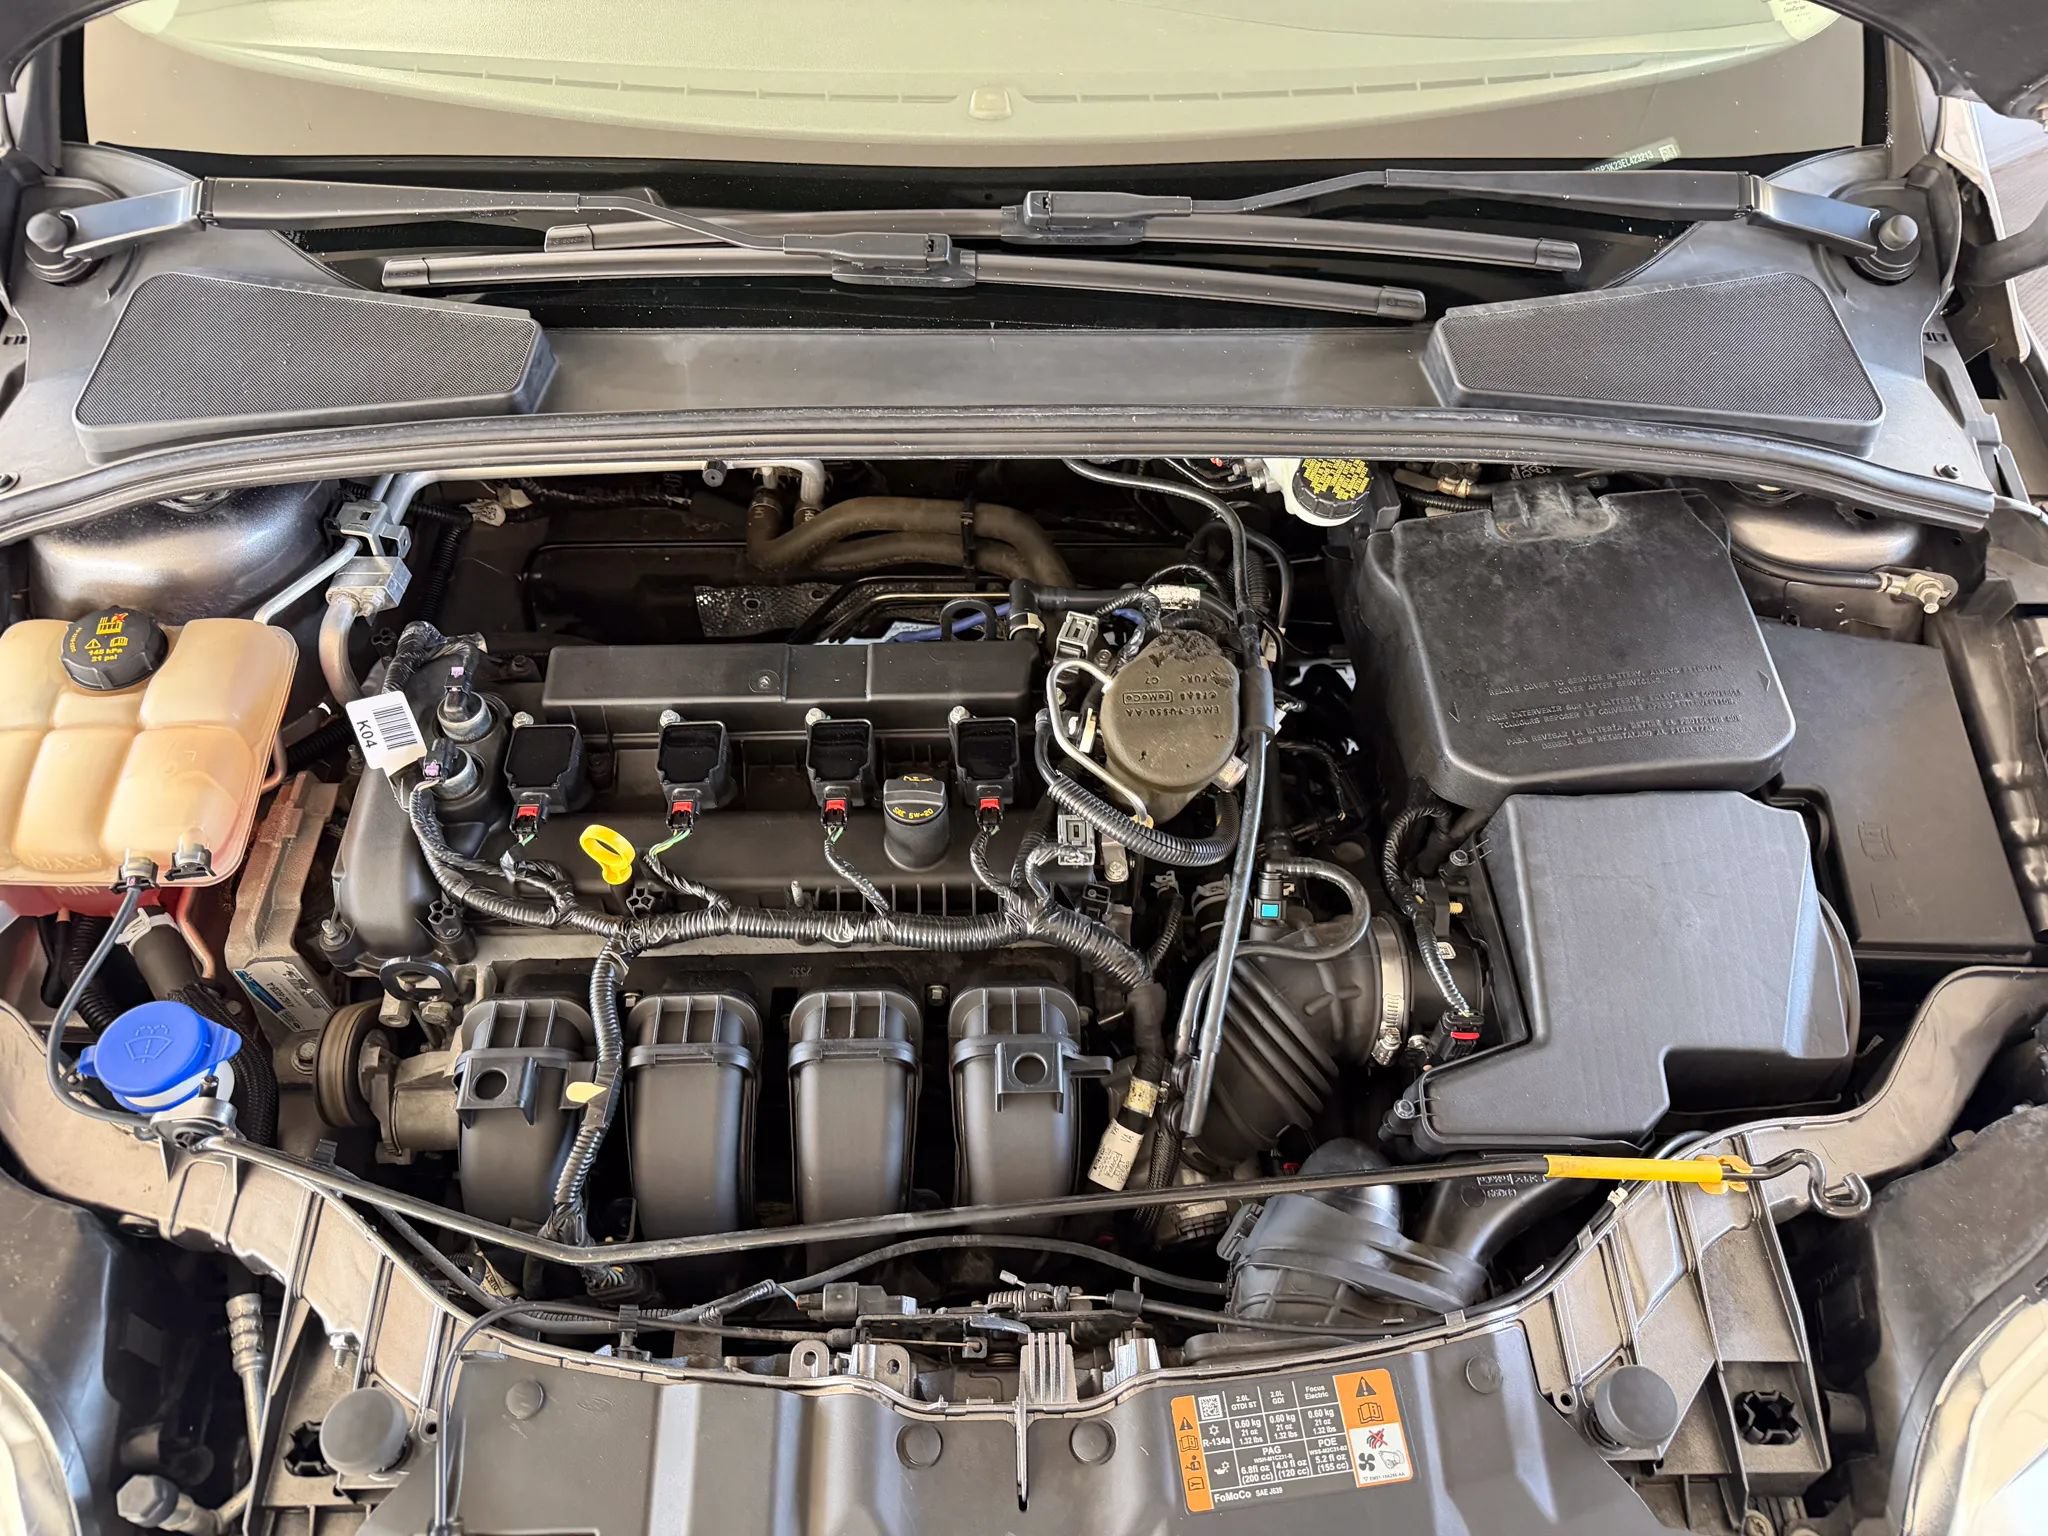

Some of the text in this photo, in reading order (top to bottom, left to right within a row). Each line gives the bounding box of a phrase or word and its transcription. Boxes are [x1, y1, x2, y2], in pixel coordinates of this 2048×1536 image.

[104, 654, 118, 662] psi
[1523, 680, 1550, 691] COVER
[1553, 679, 1565, 687] TO
[1567, 674, 1602, 686] SERVICE
[1558, 685, 1584, 695] COVER
[1588, 682, 1614, 692] AFTER
[1126, 691, 1171, 703] FoMoCo
[1585, 700, 1597, 709] LA
[1543, 712, 1581, 723] REPOSER
[356, 719, 378, 749] K04
[1506, 736, 1529, 746] PARA
[1531, 730, 1568, 742] REVISAR
[892, 806, 934, 819] SAE 5W-20
[1270, 1390, 1284, 1398] 2.0L
[1305, 1385, 1326, 1393] Focus
[1236, 1395, 1250, 1403] 2.0L
[1304, 1391, 1329, 1400] Electric
[1248, 1401, 1257, 1409] ST
[1269, 1413, 1296, 1423] 0.60 kg
[1307, 1408, 1335, 1419] 0.60 kg
[1234, 1418, 1262, 1429] 0.60 kg
[1314, 1419, 1322, 1427] 21
[1274, 1431, 1287, 1440] 1.32
[1313, 1427, 1326, 1435] 1.32
[1203, 1437, 1231, 1448] R-134a
[1239, 1435, 1263, 1445] 1.32 lbs
[1318, 1436, 1338, 1448] POE
[1262, 1445, 1281, 1456] PAG
[1276, 1459, 1308, 1469] 4.0 fl oz
[1315, 1453, 1348, 1464] 5.2 fl oz
[1240, 1464, 1271, 1475] 6.8fl oz
[1278, 1466, 1310, 1480] (120 cc)
[1317, 1461, 1349, 1474] (155 cc)
[1241, 1471, 1274, 1485] (200 cc)
[1214, 1486, 1283, 1503] FoMoCo SAE J639
